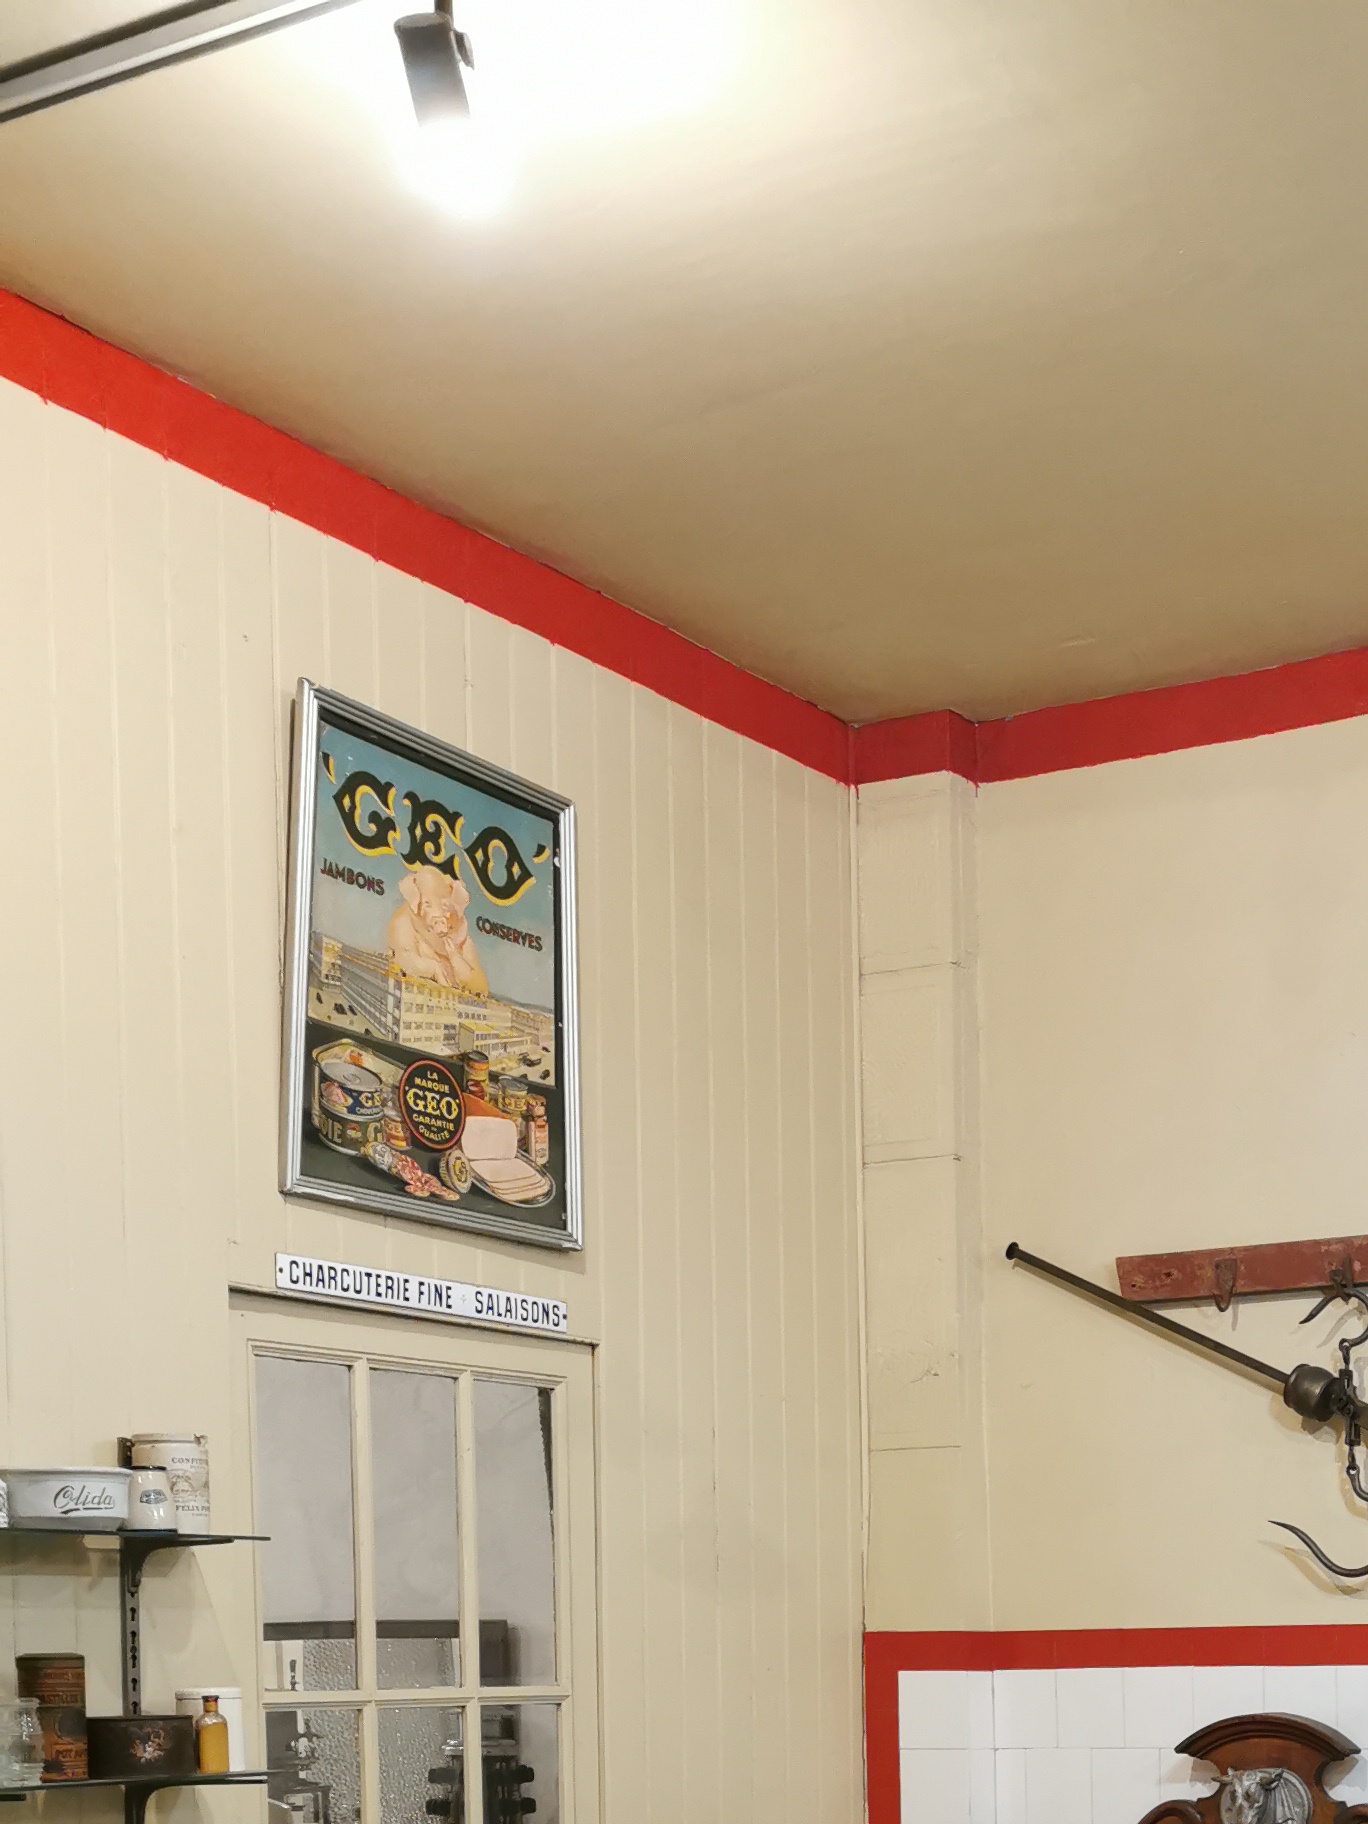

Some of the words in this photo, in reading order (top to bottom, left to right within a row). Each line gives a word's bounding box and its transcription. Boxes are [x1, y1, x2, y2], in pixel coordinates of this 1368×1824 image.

[319, 857, 386, 896] JAMBONS
[475, 916, 544, 953] CONSERVES
[413, 1076, 450, 1094] MARQUE
[427, 1070, 439, 1081] LA
[412, 1113, 455, 1132] GARANTIE
[289, 1260, 410, 1302] CHARCUTERIE
[418, 1281, 453, 1310] FINE
[475, 1290, 561, 1328] SALAISONS
